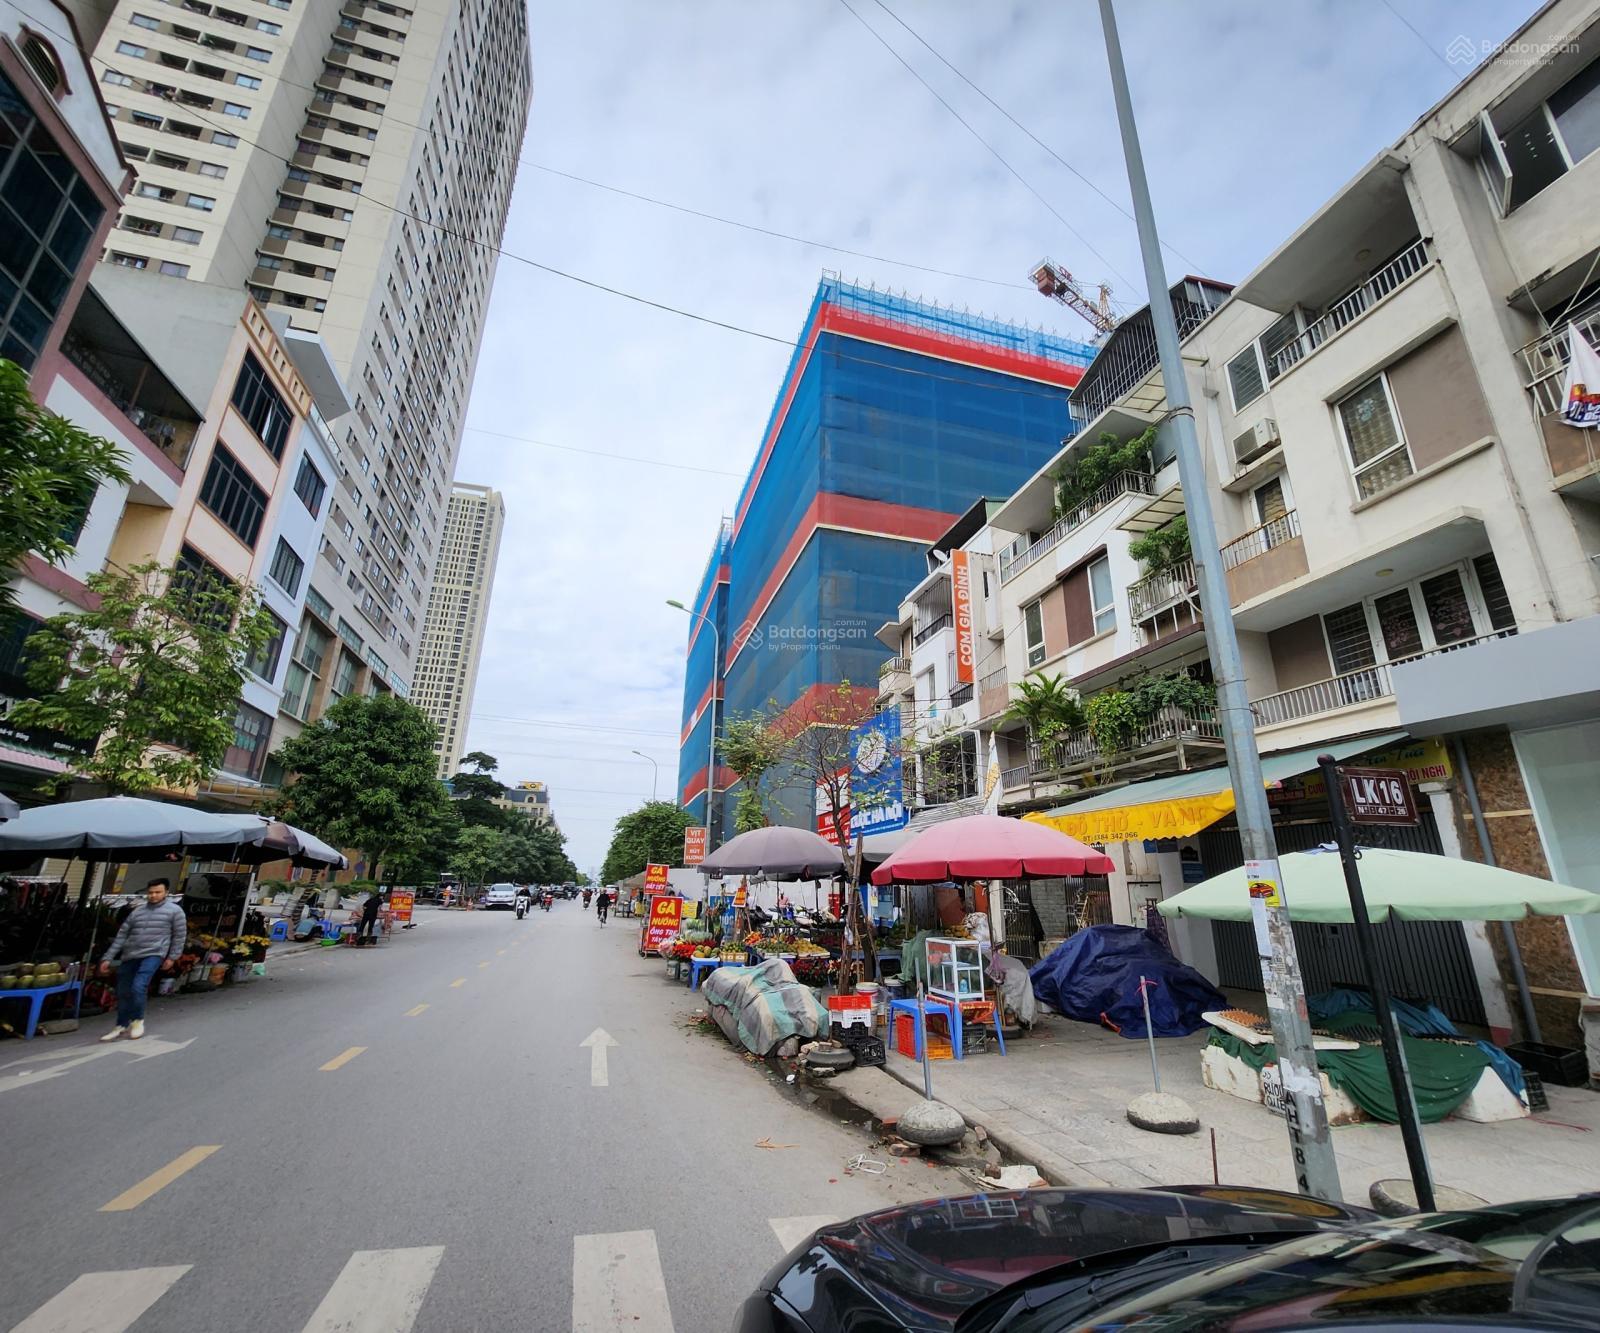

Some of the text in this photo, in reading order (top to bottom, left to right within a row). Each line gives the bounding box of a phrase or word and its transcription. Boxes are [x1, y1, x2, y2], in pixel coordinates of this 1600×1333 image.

[955, 566, 972, 666] CƠM GIA ĐÌNH
[1352, 779, 1403, 805] LK16
[651, 866, 663, 875] GÀ
[657, 900, 676, 915] GÀ
[651, 917, 679, 926] NƯỚNG
